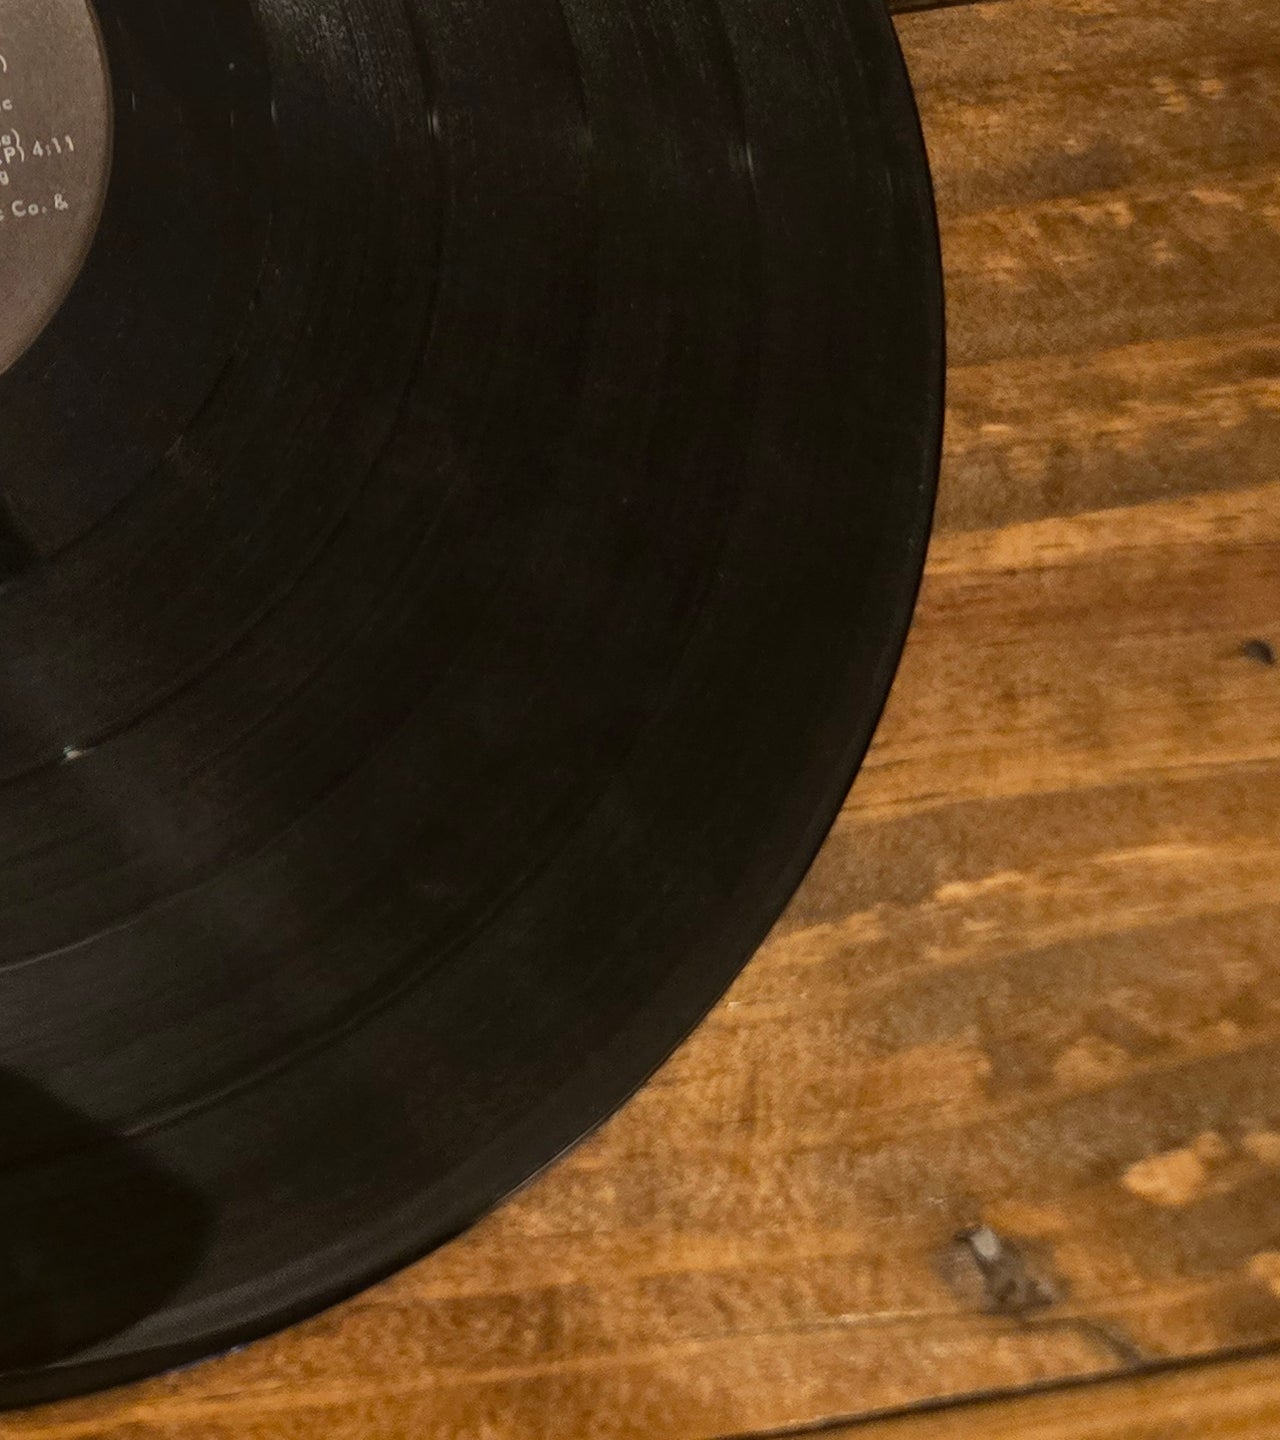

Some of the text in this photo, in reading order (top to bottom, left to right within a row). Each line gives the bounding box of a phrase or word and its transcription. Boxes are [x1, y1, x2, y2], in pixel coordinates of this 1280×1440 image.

[33, 135, 75, 157] 4:11
[11, 200, 47, 217] Co.
[53, 193, 69, 210] &
